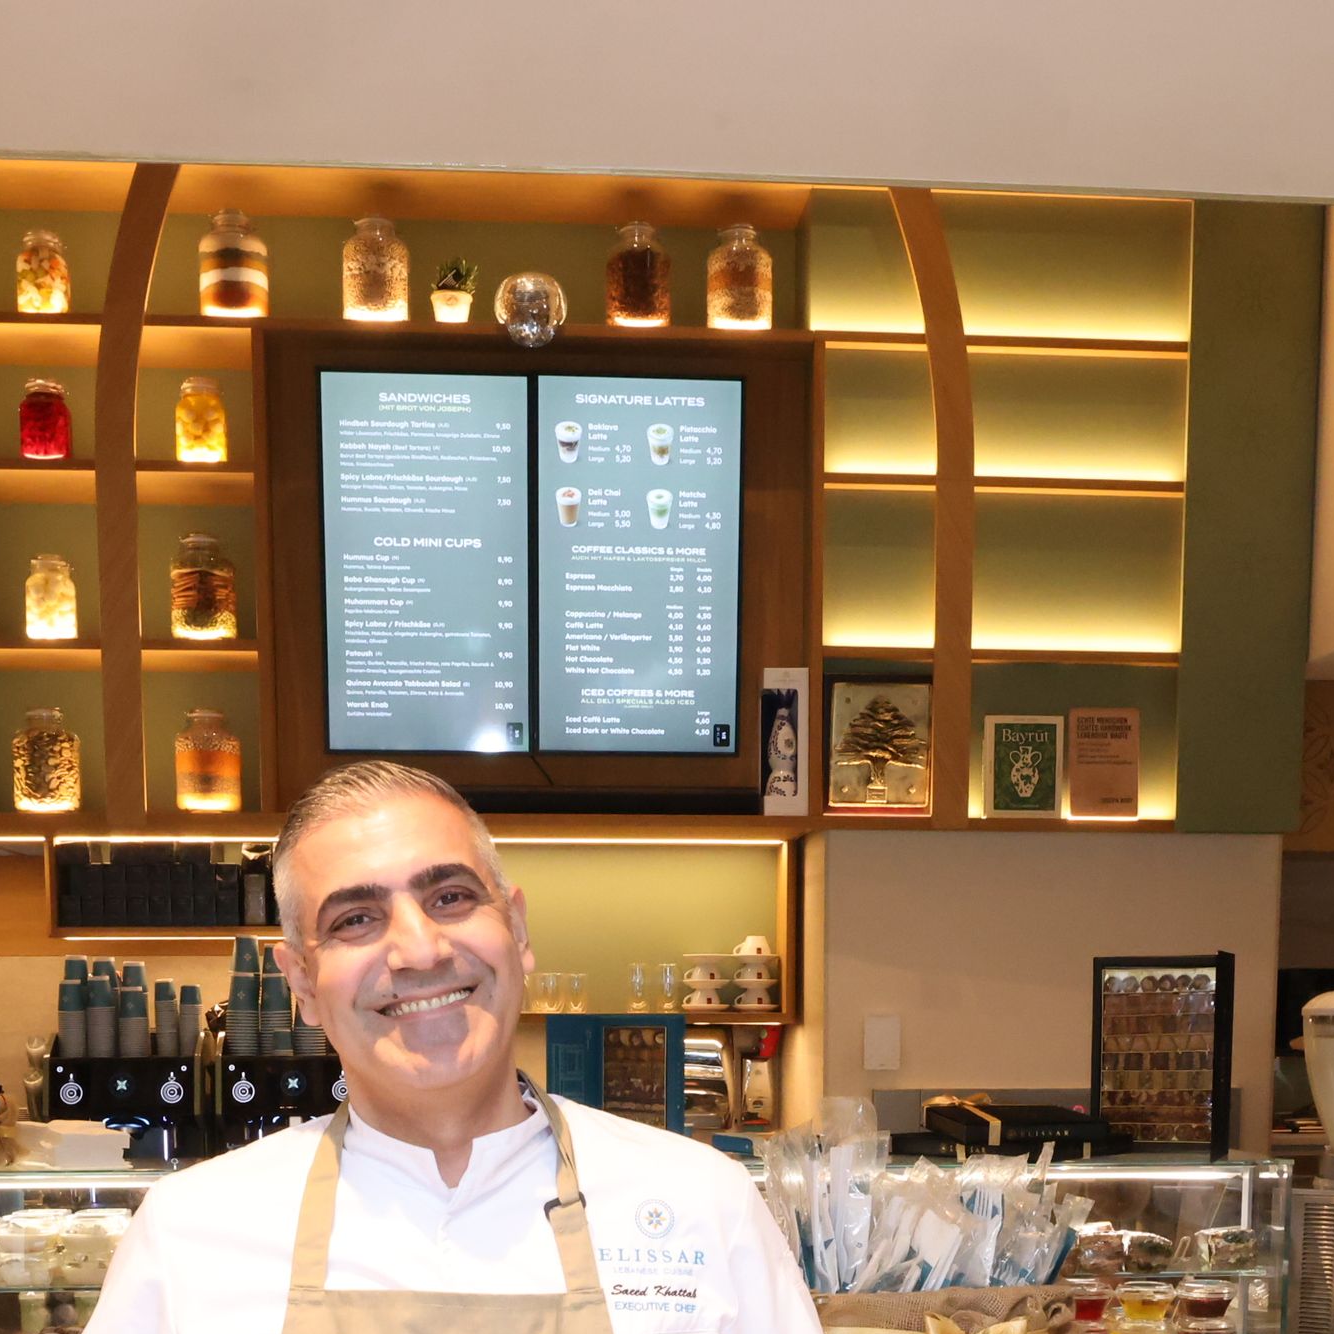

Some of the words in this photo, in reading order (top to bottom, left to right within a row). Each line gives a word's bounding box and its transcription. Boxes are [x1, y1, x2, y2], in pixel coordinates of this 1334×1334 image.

[379, 392, 471, 404] SANDWICHES
[576, 394, 652, 405] SIGNATURE
[655, 396, 705, 407] LATTES
[371, 420, 408, 429] Sourdough
[588, 423, 618, 431] Baklava
[679, 425, 717, 433] Pistacchio
[680, 435, 699, 443] Latte
[615, 444, 631, 453] 4,70
[706, 447, 722, 455] 4,70
[615, 455, 631, 463] 5,20
[707, 457, 722, 465] 5,20
[340, 473, 359, 482] Spicy
[426, 475, 463, 484] Sourdough
[374, 497, 411, 506] Sourdough
[588, 498, 607, 506] Latte
[374, 537, 411, 547] COLD
[414, 538, 442, 547] MINI
[445, 538, 482, 548] CUPS
[572, 546, 613, 554] COFFEE
[615, 546, 664, 554] CLASSICS
[676, 547, 706, 556] MORE
[376, 554, 389, 562] Cup
[402, 577, 415, 585] Cup
[566, 584, 595, 592] Espresso
[597, 584, 632, 592] Macchiato
[697, 586, 712, 594] 4,10
[390, 599, 404, 607] Cup
[345, 621, 363, 629] Spicy
[669, 623, 683, 631] 4,10
[696, 635, 711, 643] 4,10
[495, 681, 513, 689] 10,90
[607, 689, 654, 697] COFFEES
[598, 1248, 705, 1265] ELISSAR
[611, 1284, 648, 1296] Saeed
[654, 1285, 697, 1299] Khattab
[615, 1301, 670, 1311] EXECUTIVE
[675, 1303, 696, 1313] CHEF
